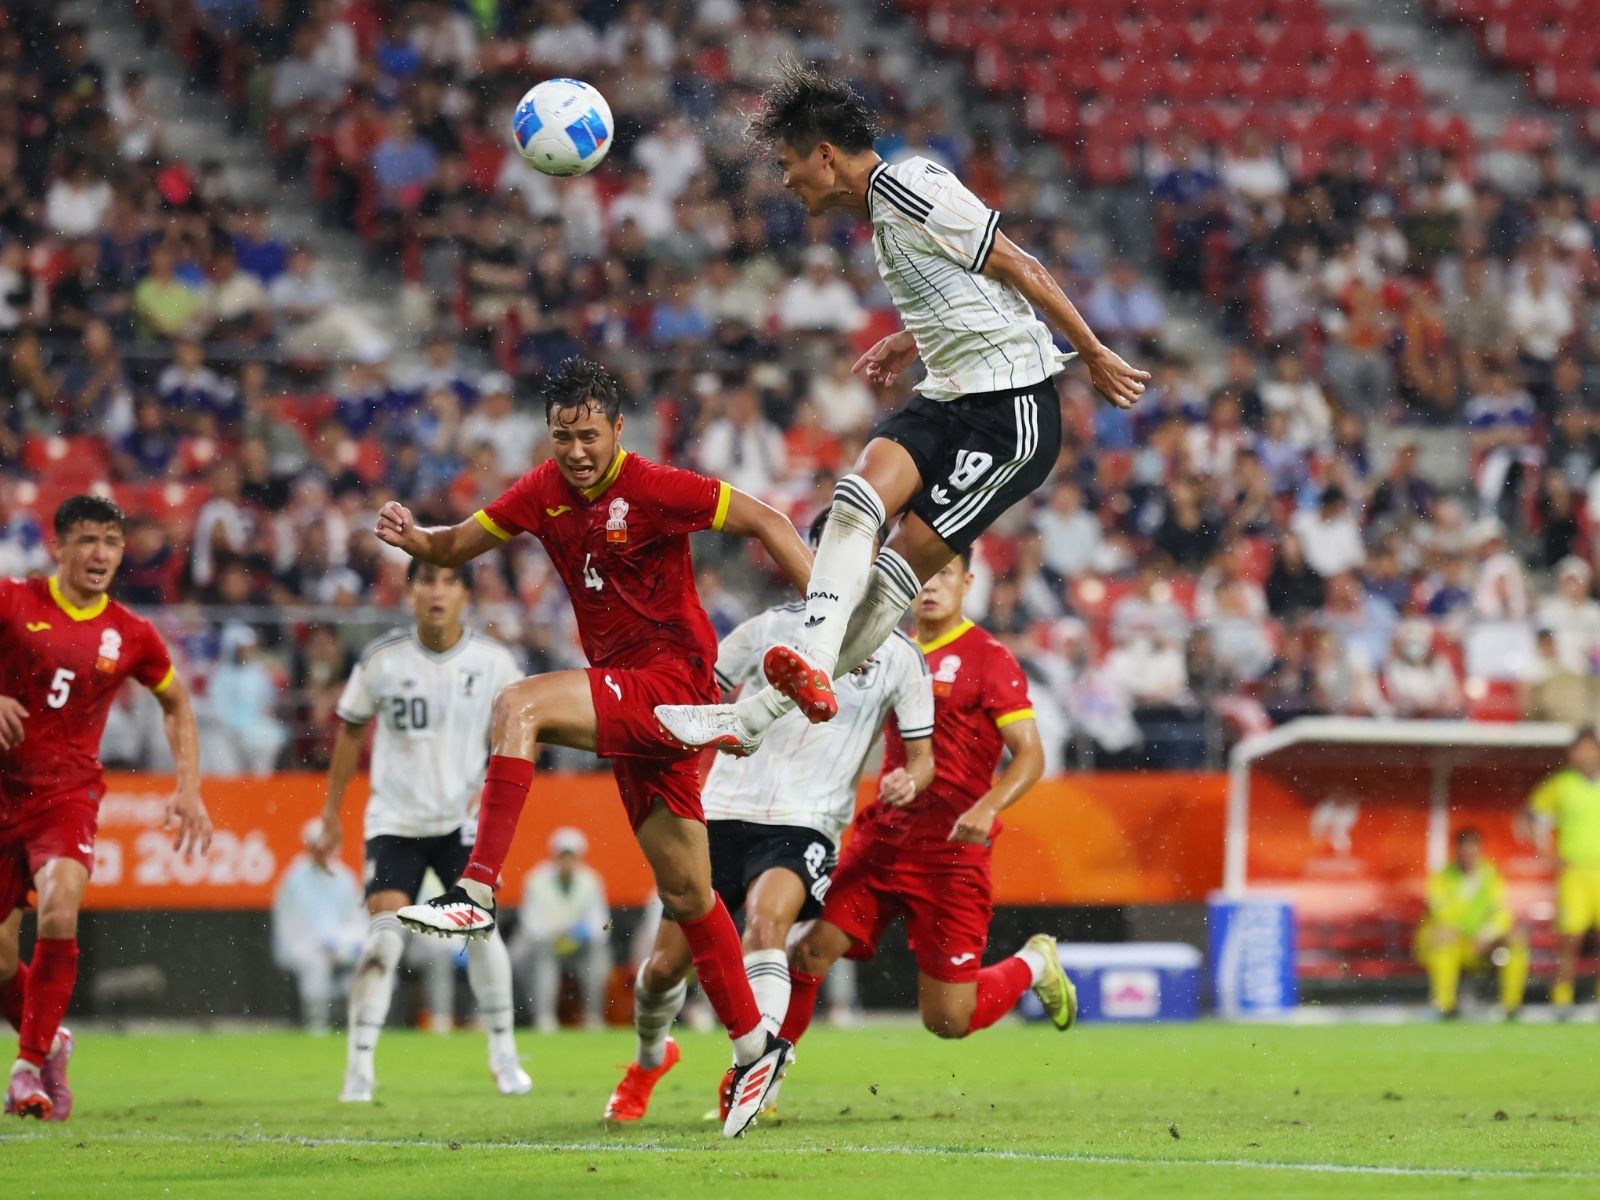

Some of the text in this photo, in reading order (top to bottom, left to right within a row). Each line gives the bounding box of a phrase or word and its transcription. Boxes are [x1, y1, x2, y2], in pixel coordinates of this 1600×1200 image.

[583, 553, 604, 591] 4
[47, 667, 76, 709] 5
[392, 697, 427, 731] 20
[134, 829, 276, 885] 2026
